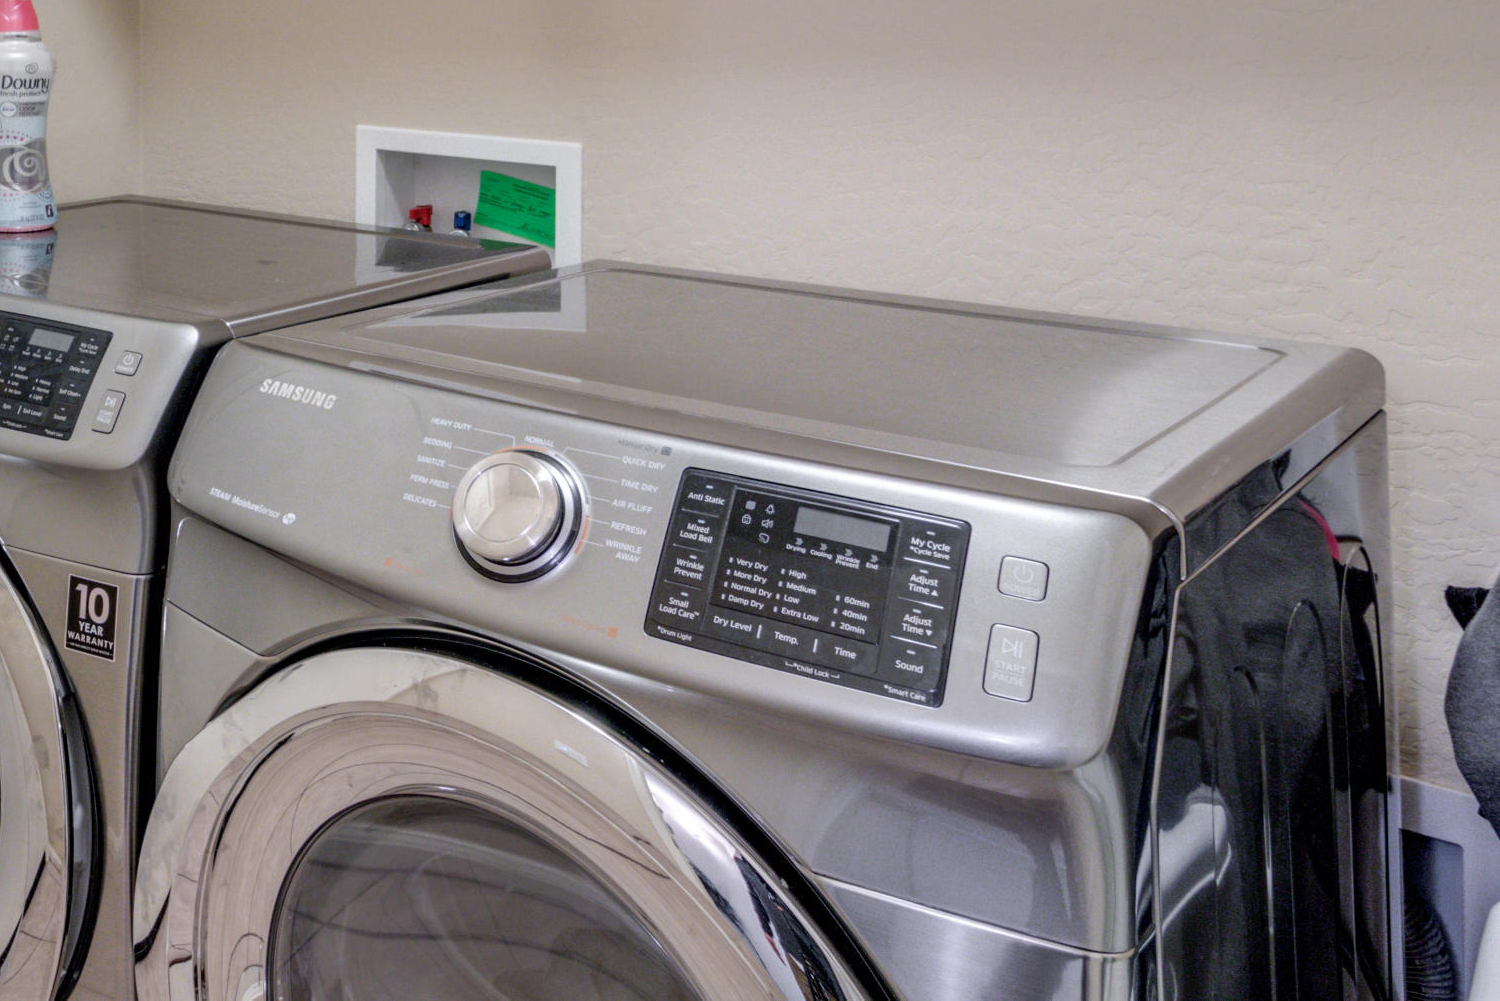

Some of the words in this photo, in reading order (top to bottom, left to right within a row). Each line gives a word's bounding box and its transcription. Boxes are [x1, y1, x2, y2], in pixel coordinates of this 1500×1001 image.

[1, 74, 50, 94] Downy
[260, 378, 337, 410] SAMSUNG
[453, 421, 472, 431] DUTY
[524, 435, 554, 448] NORMAL
[622, 455, 646, 467] QUICK
[647, 460, 665, 471] DRY
[620, 478, 640, 490] TIME
[641, 483, 658, 493] DRY
[687, 491, 703, 501] Anti
[704, 494, 725, 506] Static
[612, 499, 626, 509] AIR
[627, 502, 653, 513] FLUFF
[610, 521, 648, 536] REFRESH
[686, 522, 710, 534] Mixed
[679, 530, 697, 541] Load
[698, 534, 713, 544] Bell
[605, 539, 642, 554] WRINKLE
[785, 543, 807, 555] Drying
[910, 536, 926, 548] My
[926, 540, 951, 553] Cycle
[615, 551, 640, 563] AWAY
[932, 550, 950, 561] Save
[676, 558, 705, 572] Wrinkle
[736, 557, 754, 568] Very
[754, 561, 769, 572] Dry
[865, 561, 879, 570] End
[673, 566, 702, 580] Prevent
[733, 569, 752, 580] More
[753, 574, 768, 585] Dry
[788, 569, 807, 580] High
[909, 574, 939, 587] Adjust
[730, 582, 757, 595] Normal
[757, 588, 772, 599] Dry
[786, 581, 817, 595] Medium
[908, 582, 931, 595] Time
[75, 583, 110, 625] 10
[668, 596, 689, 608] Small
[728, 594, 750, 606] Damp
[750, 599, 764, 610] Dry
[783, 594, 800, 604] Low
[844, 596, 870, 609] 60min
[658, 604, 677, 615] Load
[781, 607, 801, 618] Extra
[802, 612, 820, 623] Low
[842, 609, 868, 622] 40min
[713, 615, 729, 628] Dry
[729, 620, 753, 632] Level
[902, 613, 933, 628] Adjust
[78, 620, 104, 637] YEAR
[839, 621, 866, 635] 20min
[901, 622, 924, 636] Time
[67, 630, 114, 650] WARRANTY
[774, 630, 799, 646] Temp.
[833, 645, 857, 660] Time
[814, 668, 830, 679] Lock
[894, 659, 924, 674] Sound
[909, 690, 927, 702] Care
